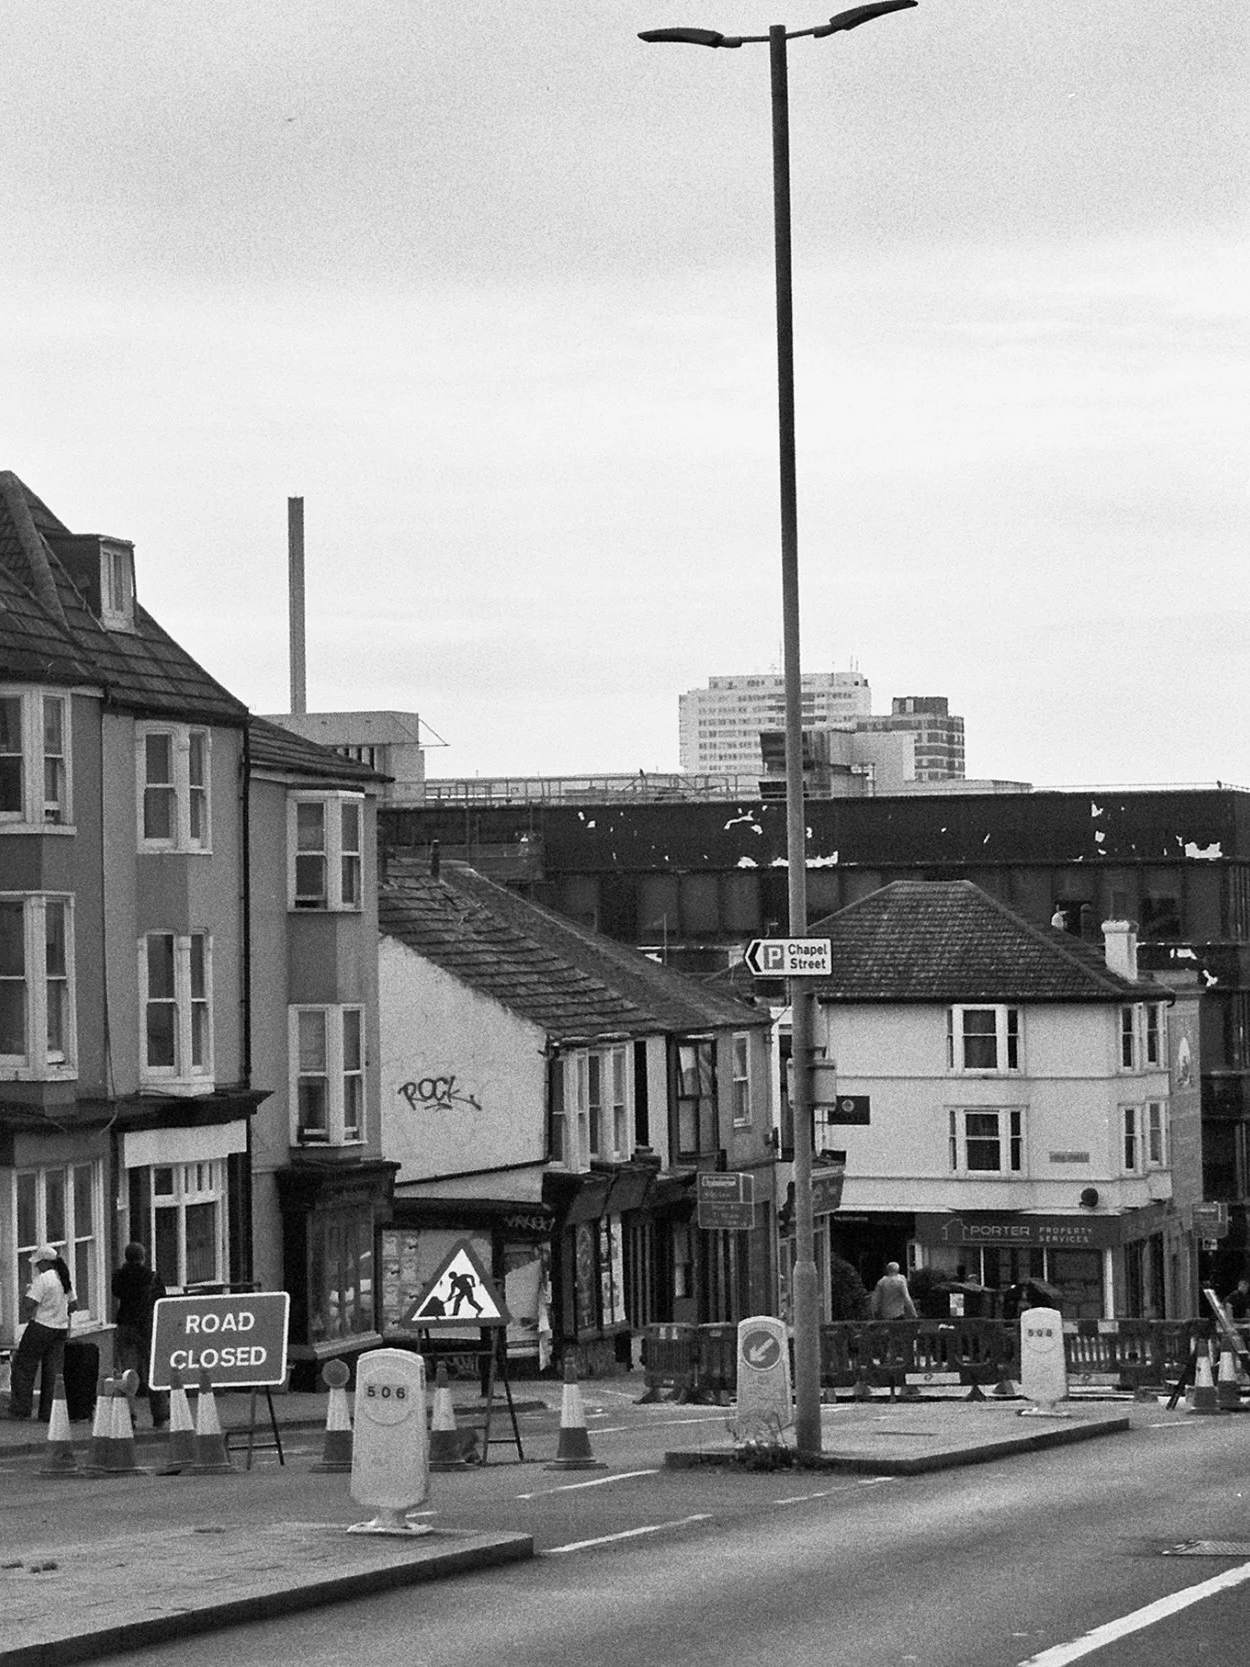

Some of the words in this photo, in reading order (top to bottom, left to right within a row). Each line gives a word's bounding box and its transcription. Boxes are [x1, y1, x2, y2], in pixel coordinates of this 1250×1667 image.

[788, 943, 828, 957] Chapel
[768, 947, 782, 968] P
[789, 957, 827, 970] Street
[969, 1225, 1031, 1237] PORTER
[1038, 1226, 1093, 1235] PROPERTY
[1038, 1235, 1090, 1243] SERVICES
[185, 1311, 255, 1334] ROAD
[169, 1346, 267, 1370] CLOSED
[366, 1385, 407, 1400] 506
